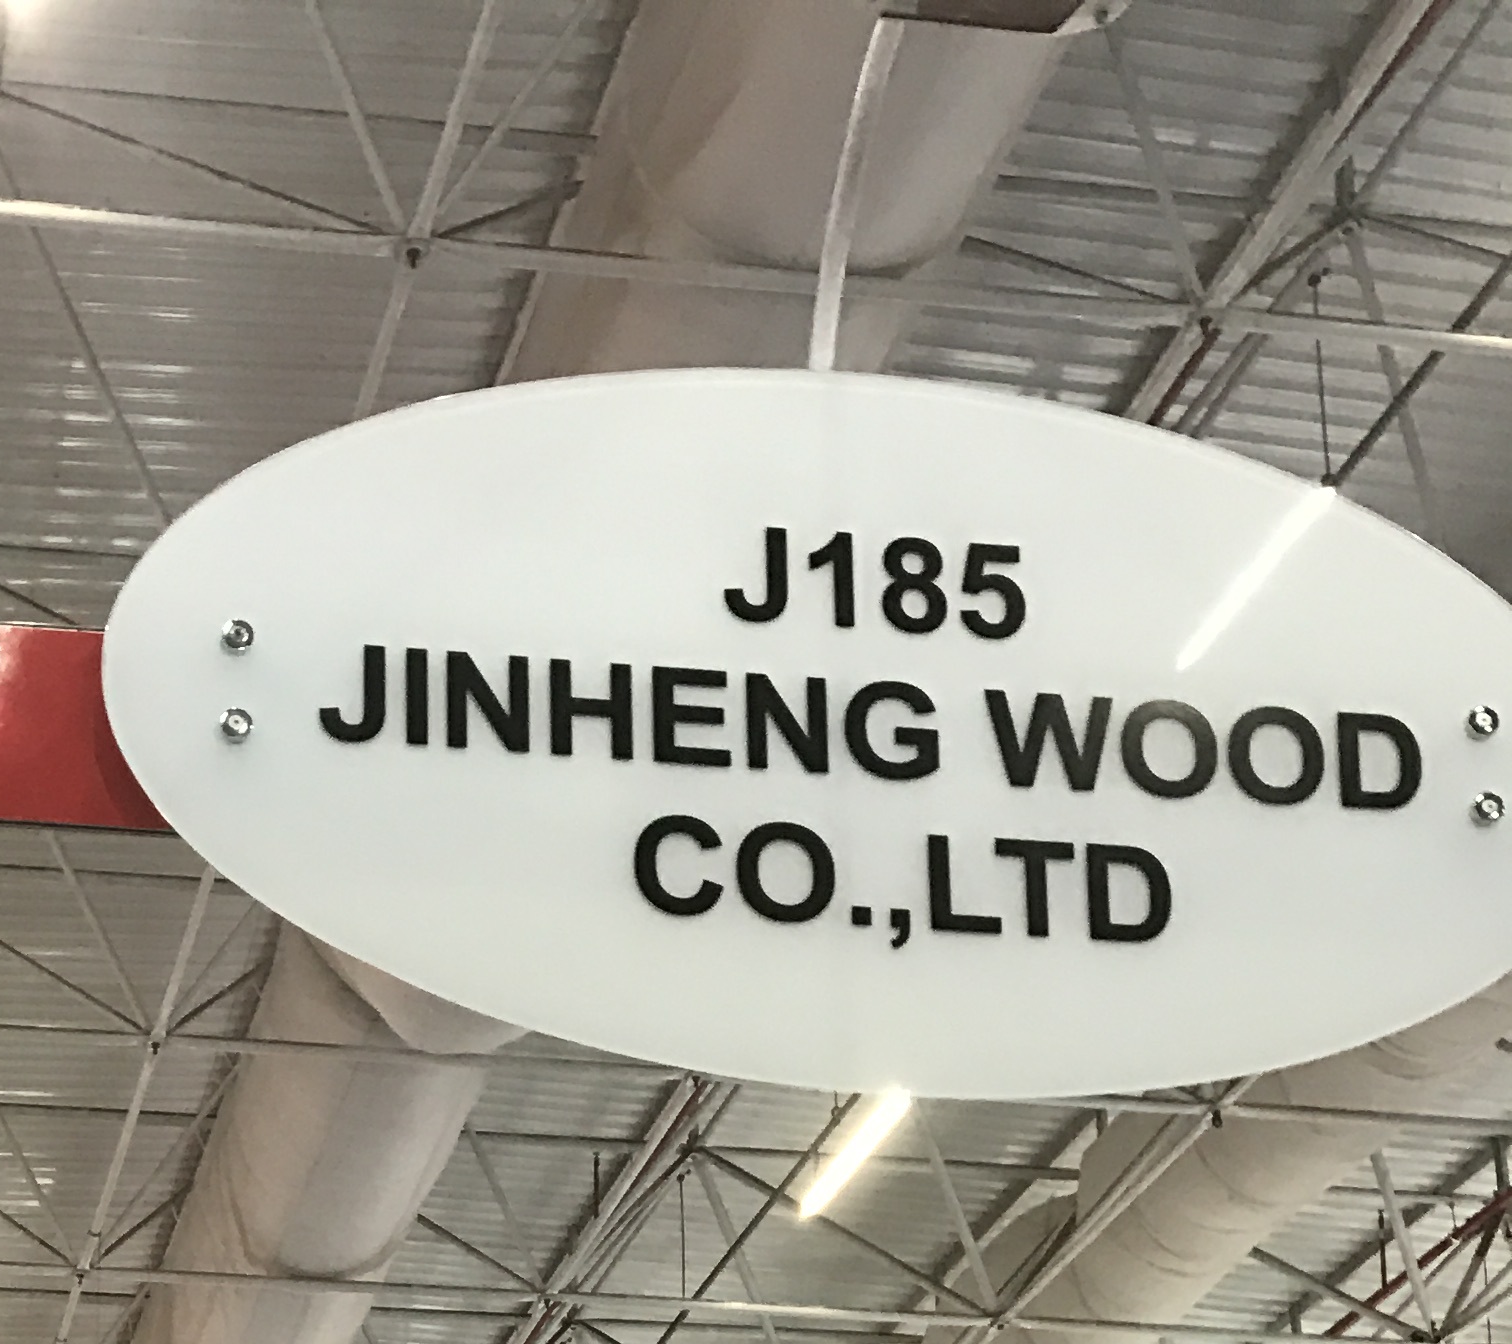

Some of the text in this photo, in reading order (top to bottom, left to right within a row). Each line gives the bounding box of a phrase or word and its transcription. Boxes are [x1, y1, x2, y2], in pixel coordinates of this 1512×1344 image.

[722, 525, 1028, 641] J185
[318, 643, 1423, 812] JINHENG WOOD
[632, 813, 1173, 951] CO.,LTD
